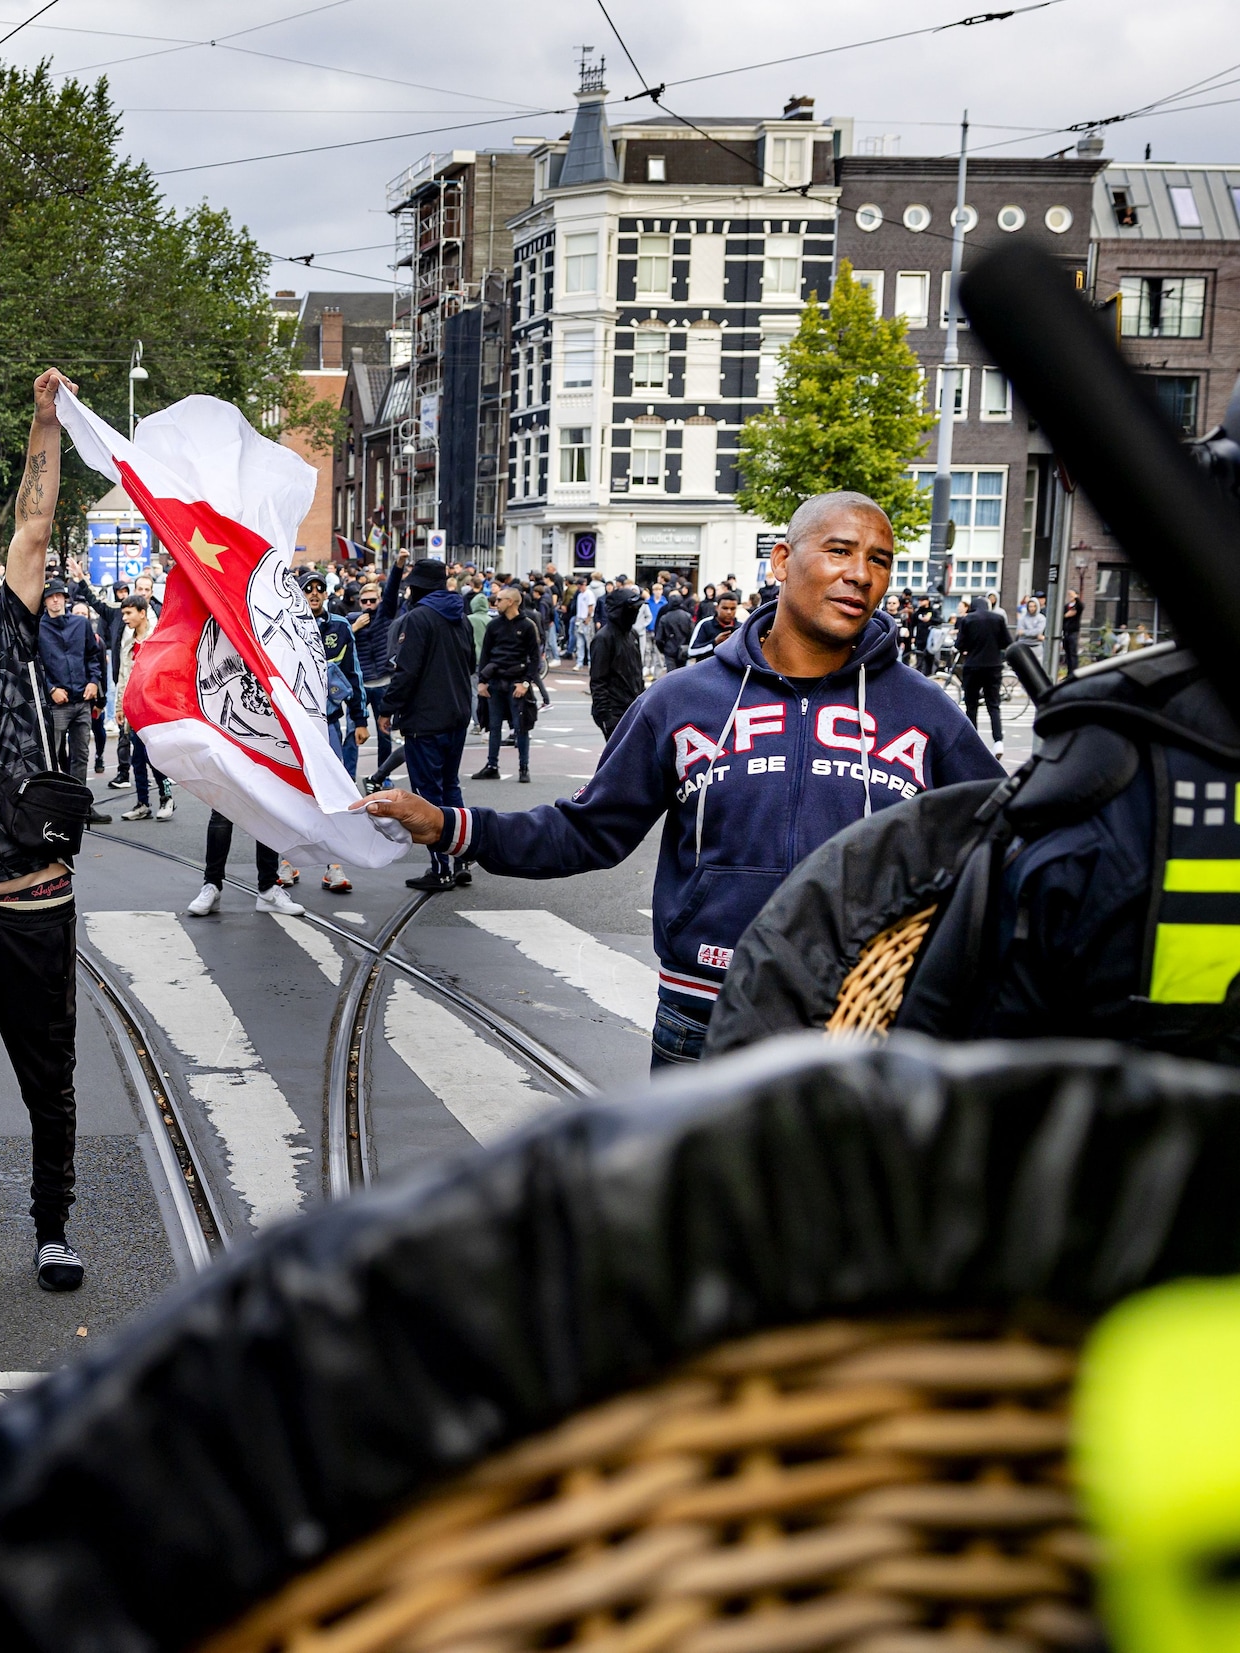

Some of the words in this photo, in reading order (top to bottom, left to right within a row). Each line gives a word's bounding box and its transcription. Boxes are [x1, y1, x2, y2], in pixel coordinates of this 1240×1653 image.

[676, 765, 731, 803] CANT
[747, 756, 786, 775] BE
[811, 759, 918, 799] STOPPE
